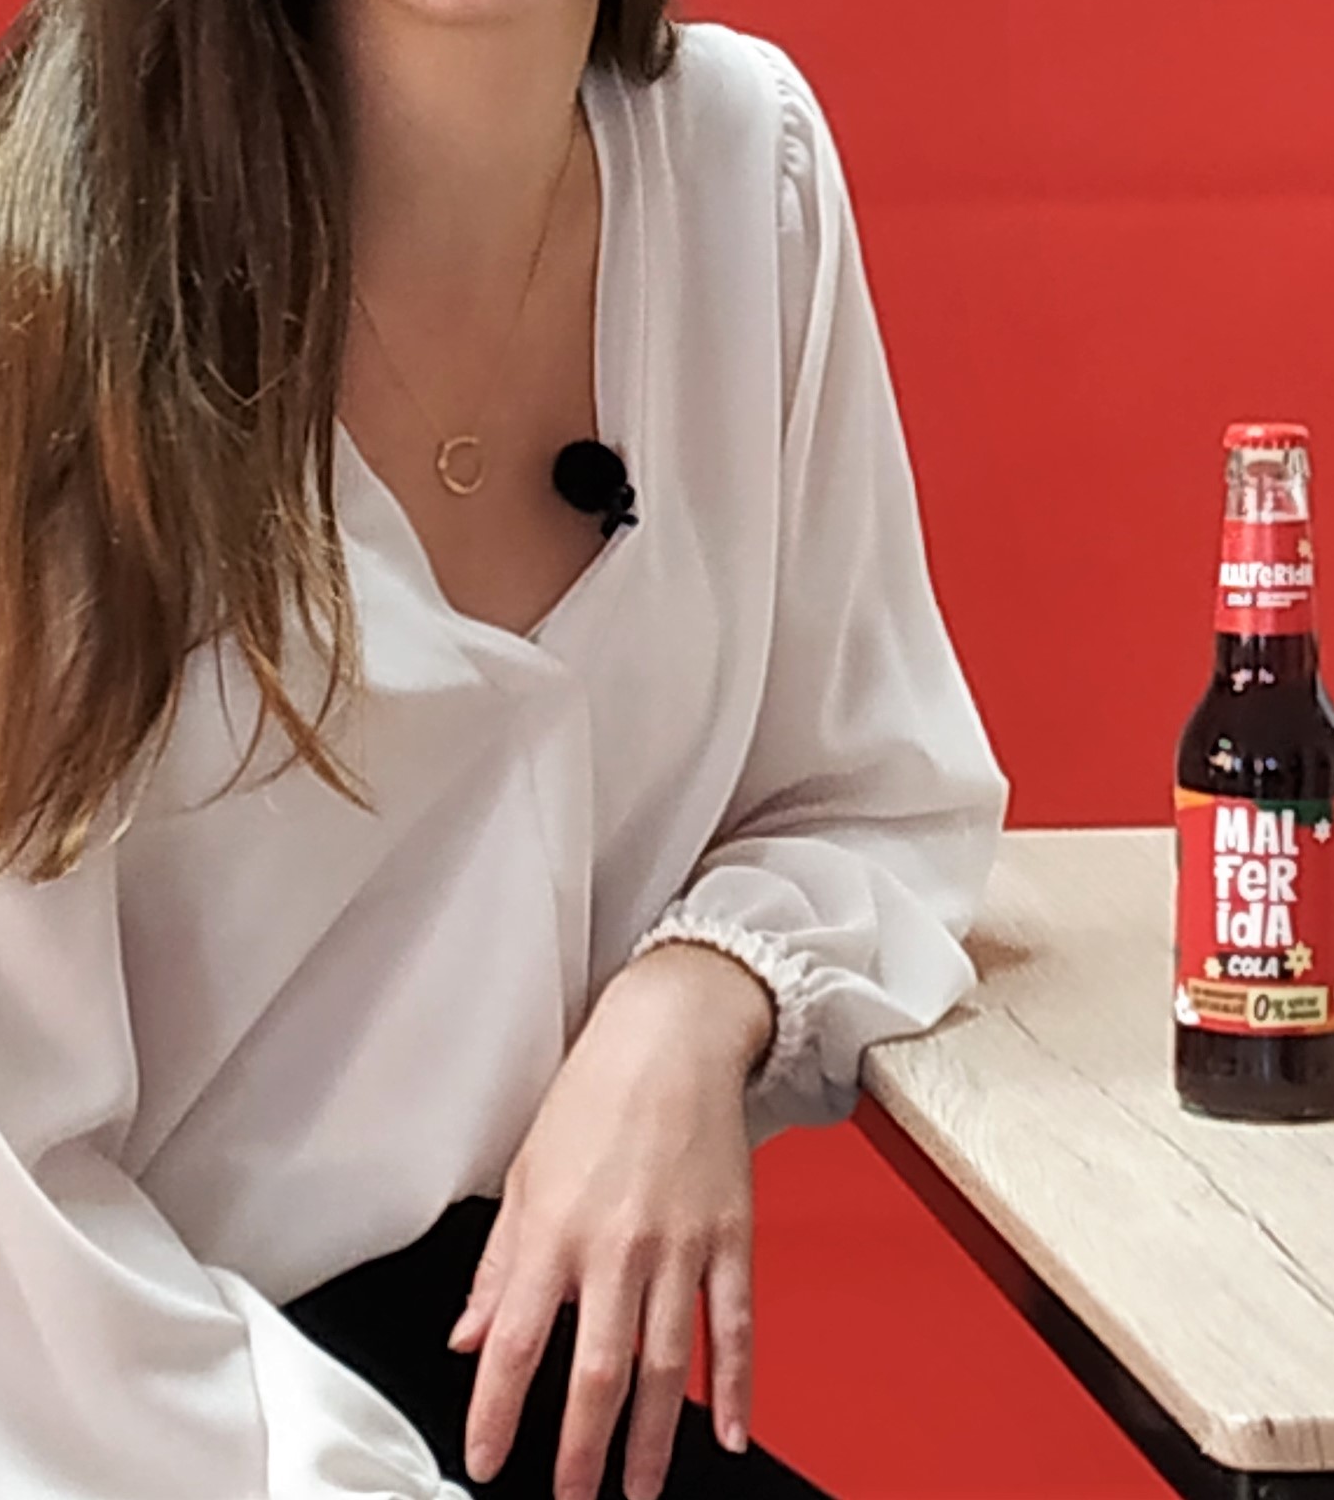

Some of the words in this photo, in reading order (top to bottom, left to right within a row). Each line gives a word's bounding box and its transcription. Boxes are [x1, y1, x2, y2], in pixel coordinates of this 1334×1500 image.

[1214, 806, 1300, 855] MAL
[1213, 855, 1298, 902] FeR
[1216, 901, 1295, 948] idA
[1227, 954, 1280, 978] COLA
